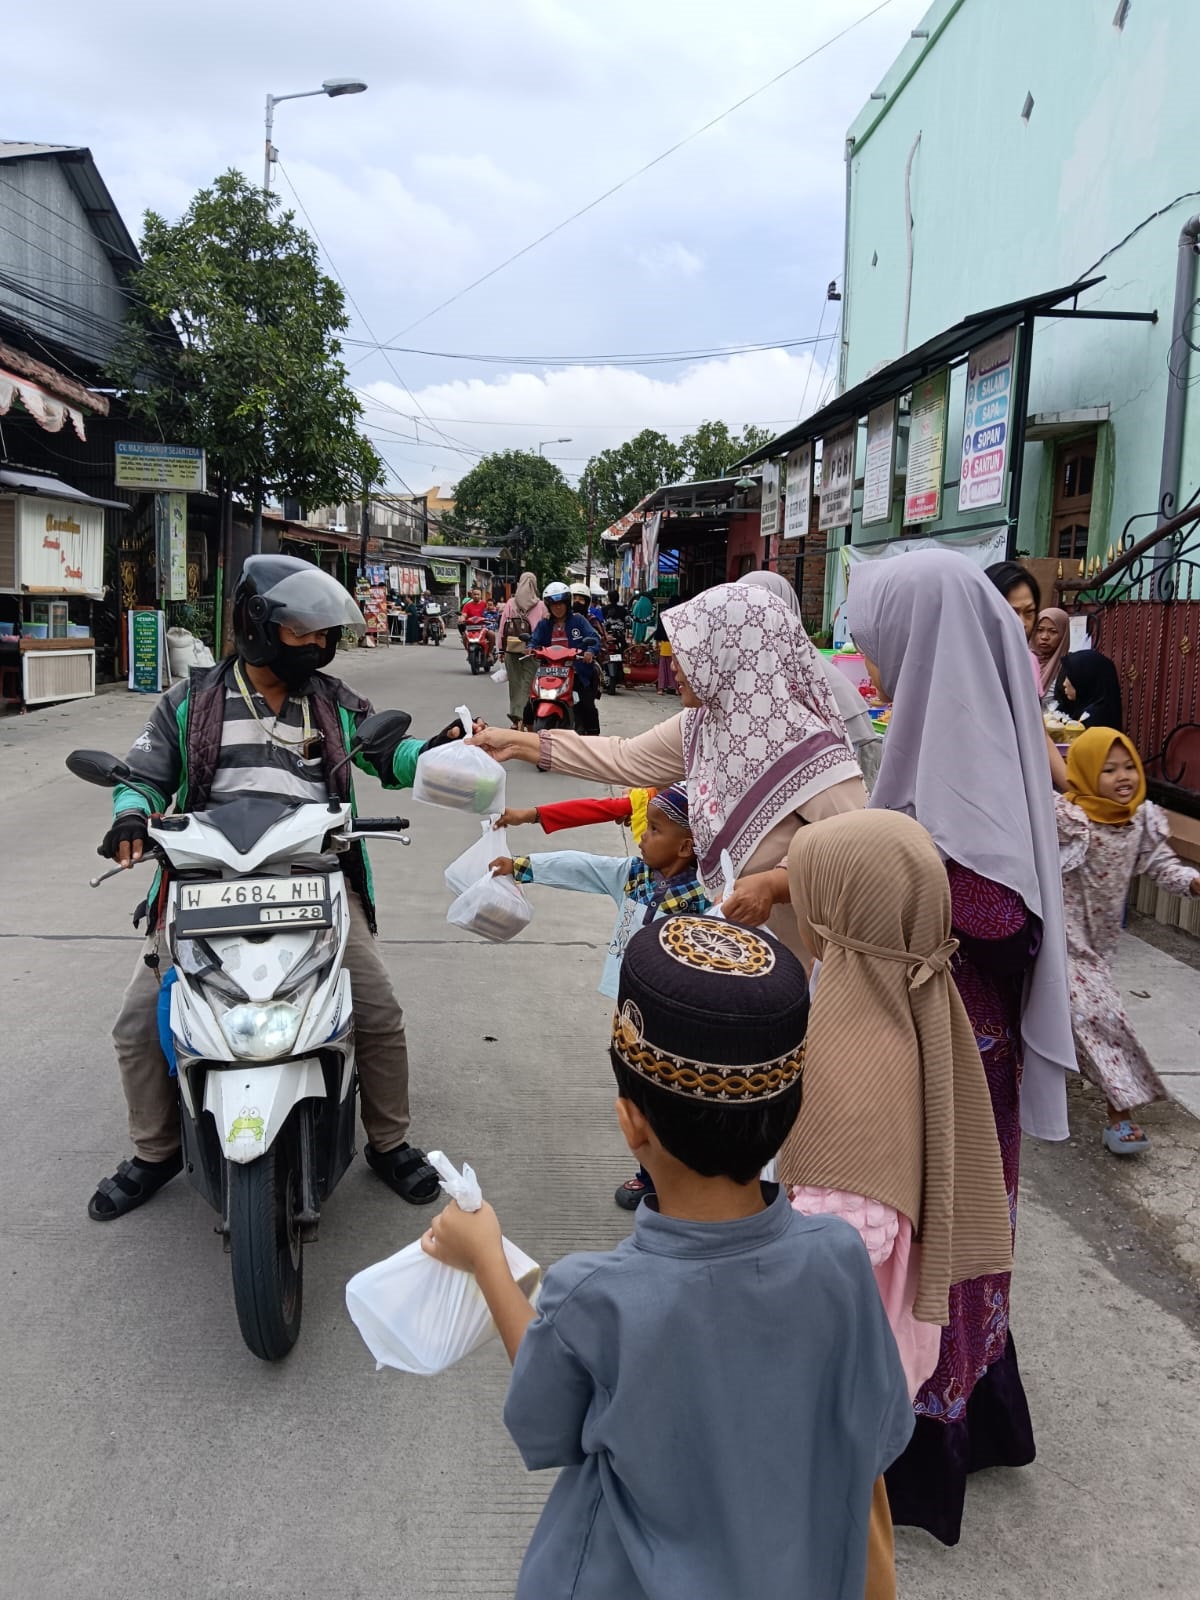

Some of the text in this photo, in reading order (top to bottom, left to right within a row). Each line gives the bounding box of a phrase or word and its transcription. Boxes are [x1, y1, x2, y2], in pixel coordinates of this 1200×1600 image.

[981, 372, 1006, 397] SALAM
[981, 401, 1000, 422] SAPA
[977, 427, 1001, 449] SOPAN
[831, 450, 852, 480] PGRI
[973, 453, 1001, 476] SANTUN
[188, 889, 201, 907] W
[221, 884, 277, 904] 4684
